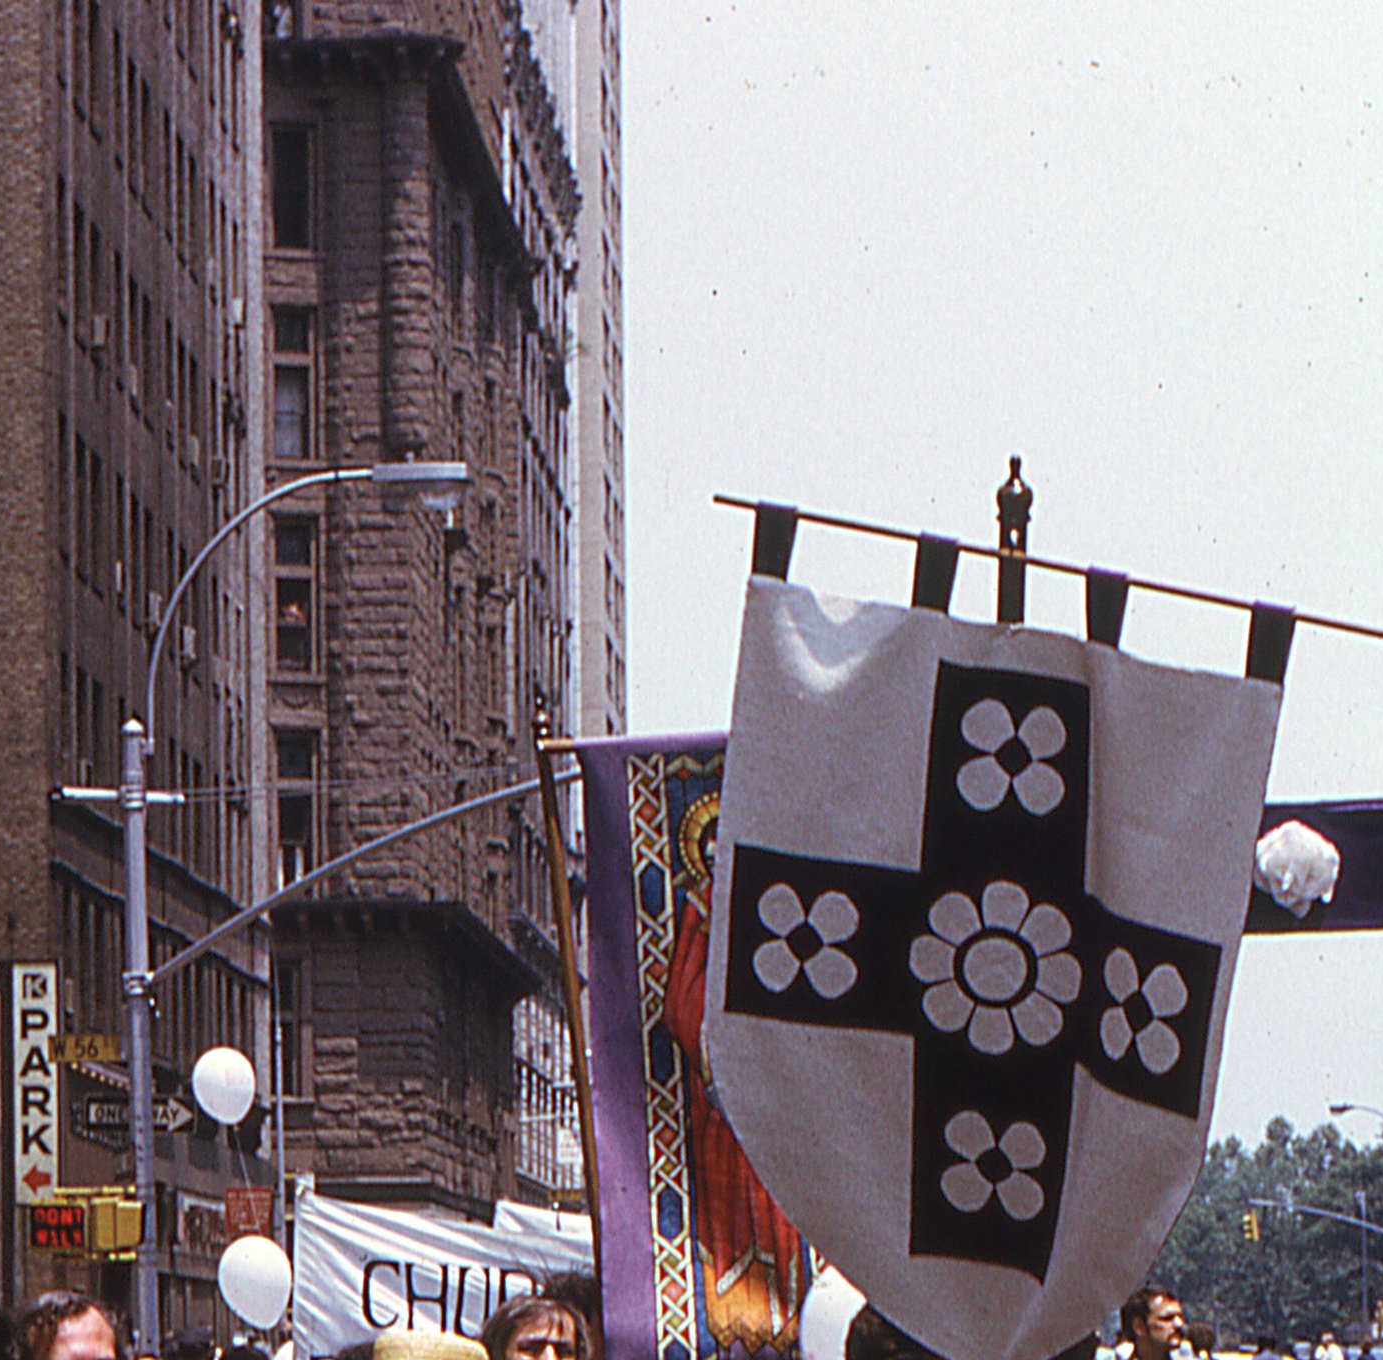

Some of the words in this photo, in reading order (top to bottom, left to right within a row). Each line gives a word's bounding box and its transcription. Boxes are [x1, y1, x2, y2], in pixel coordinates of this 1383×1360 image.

[21, 972, 48, 1000] K
[53, 1036, 67, 1057] W
[74, 1035, 99, 1057] 56
[19, 1008, 52, 1156] PARK
[153, 1103, 181, 1121] AY
